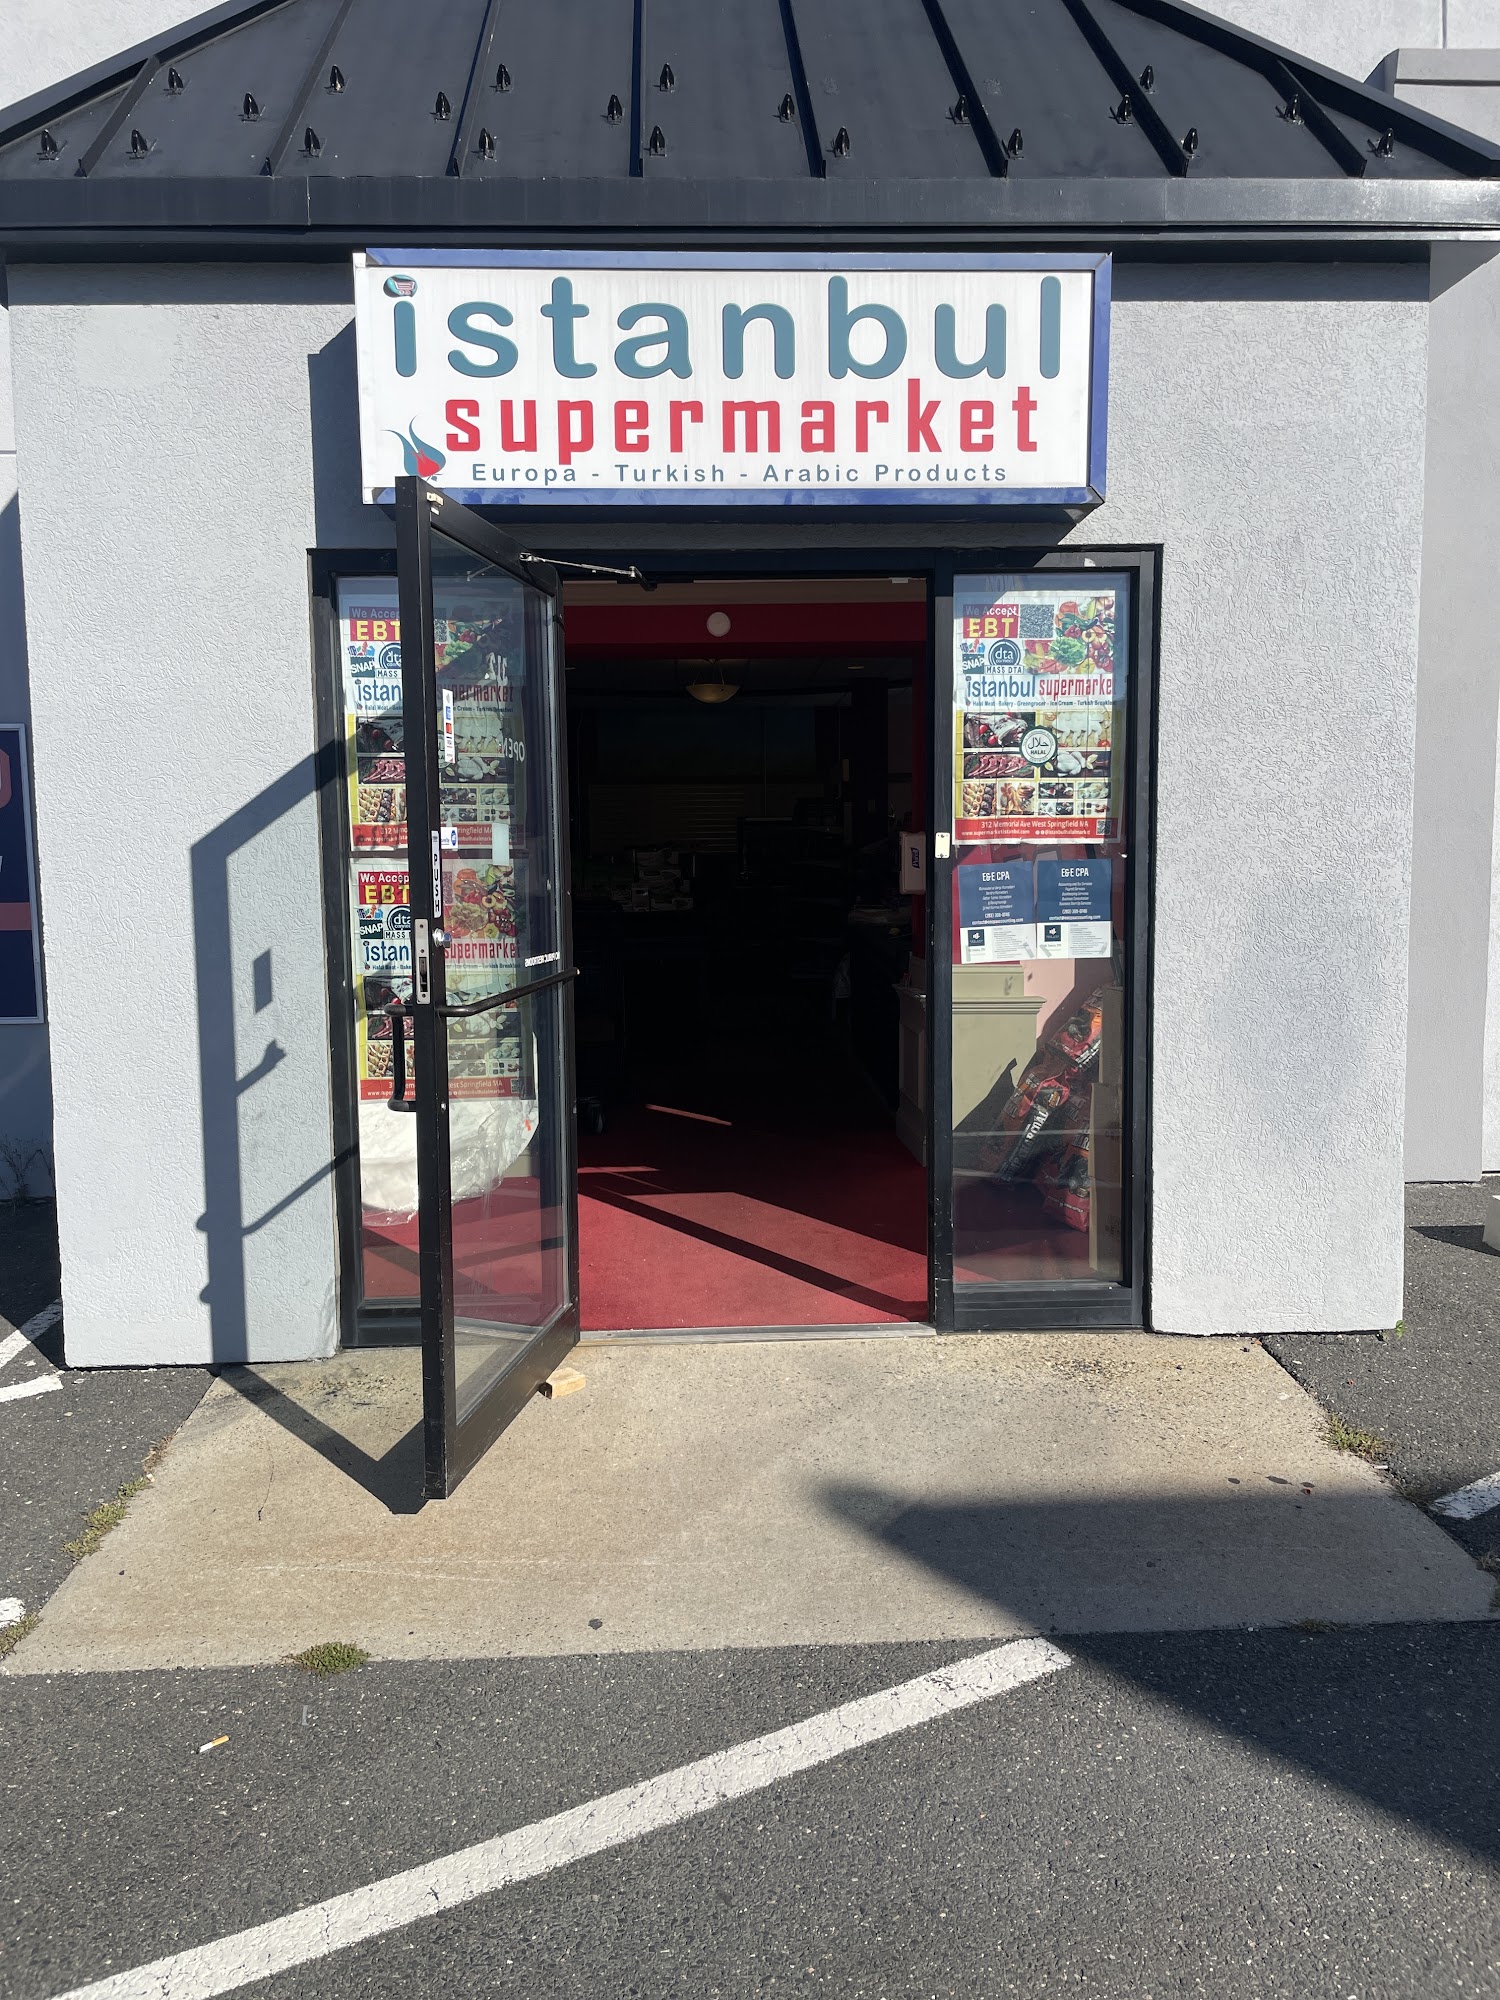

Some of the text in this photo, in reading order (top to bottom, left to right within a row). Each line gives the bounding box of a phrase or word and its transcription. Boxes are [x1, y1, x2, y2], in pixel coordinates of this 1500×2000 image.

[391, 275, 1061, 379] istanbul
[446, 379, 1038, 465] supermarket
[472, 464, 578, 486] Europa
[614, 463, 726, 483] Turkish
[762, 463, 860, 483] Arabic
[874, 463, 1009, 483] Products
[352, 608, 400, 619] We Accep
[966, 605, 1018, 618] We Accept
[969, 617, 1014, 638] EBT
[995, 647, 1014, 660] dta
[351, 659, 375, 674] SNAP
[962, 657, 984, 671] SNAP
[987, 666, 1022, 674] MASS DTA
[357, 679, 403, 702] istan
[437, 683, 514, 702] spermarket
[966, 675, 1036, 698] istanbul
[1028, 736, 1050, 750] حلال
[458, 827, 483, 835] ringfield
[1032, 820, 1046, 828] West
[1048, 820, 1078, 829] Springfield
[360, 873, 410, 884] We Accep
[982, 871, 1010, 881] E&E CPA
[1061, 868, 1089, 877] E&E CPA
[365, 884, 410, 904] EBT
[360, 923, 383, 936] SNAP
[364, 941, 410, 962] istan
[445, 939, 522, 964] supermarket
